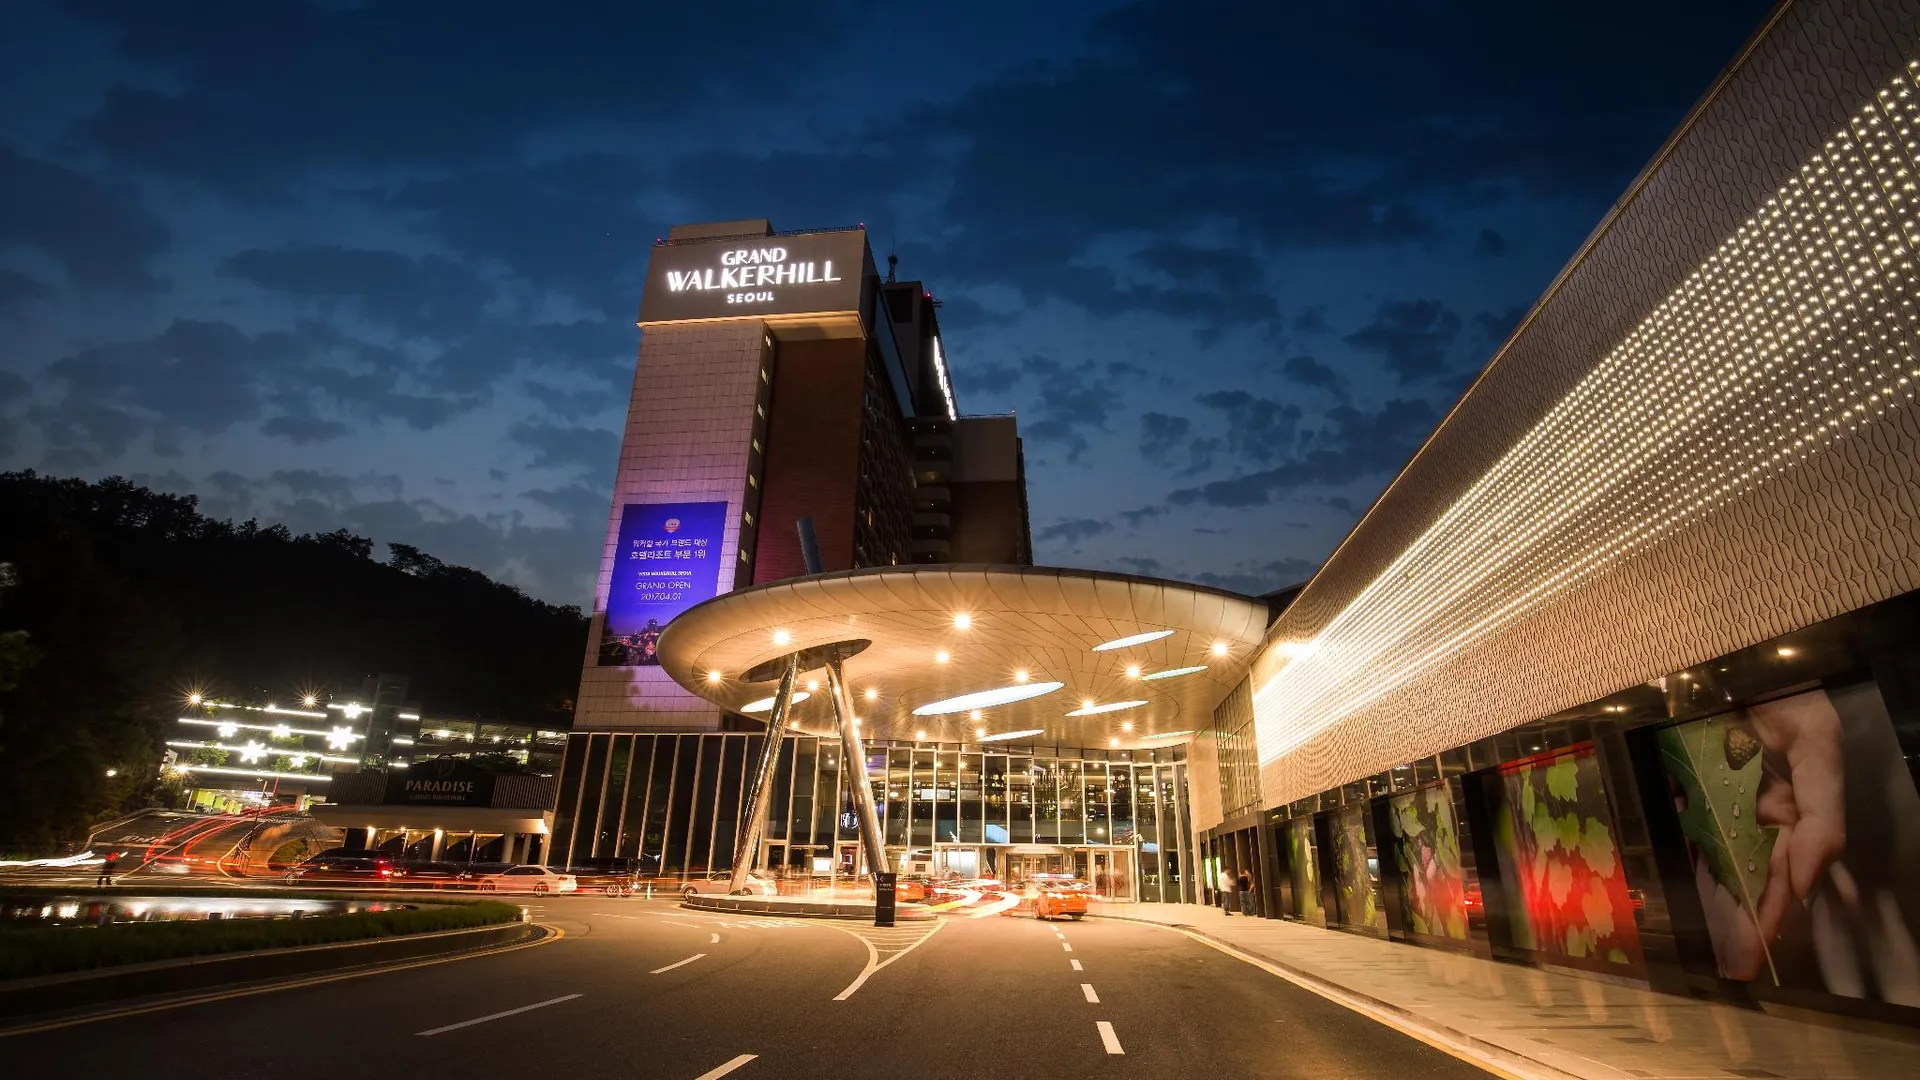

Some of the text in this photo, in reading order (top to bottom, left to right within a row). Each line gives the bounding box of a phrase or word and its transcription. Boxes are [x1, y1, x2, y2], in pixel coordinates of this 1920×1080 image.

[721, 247, 787, 266] GRAND
[667, 260, 842, 292] WALKERHILL
[726, 291, 774, 304] SEOUL
[671, 538, 692, 547] 브랜드
[630, 549, 672, 560] 호텔리조트
[674, 549, 691, 560] 부문
[635, 581, 691, 590] GRAND OPEN
[405, 780, 474, 793] PARADISE
